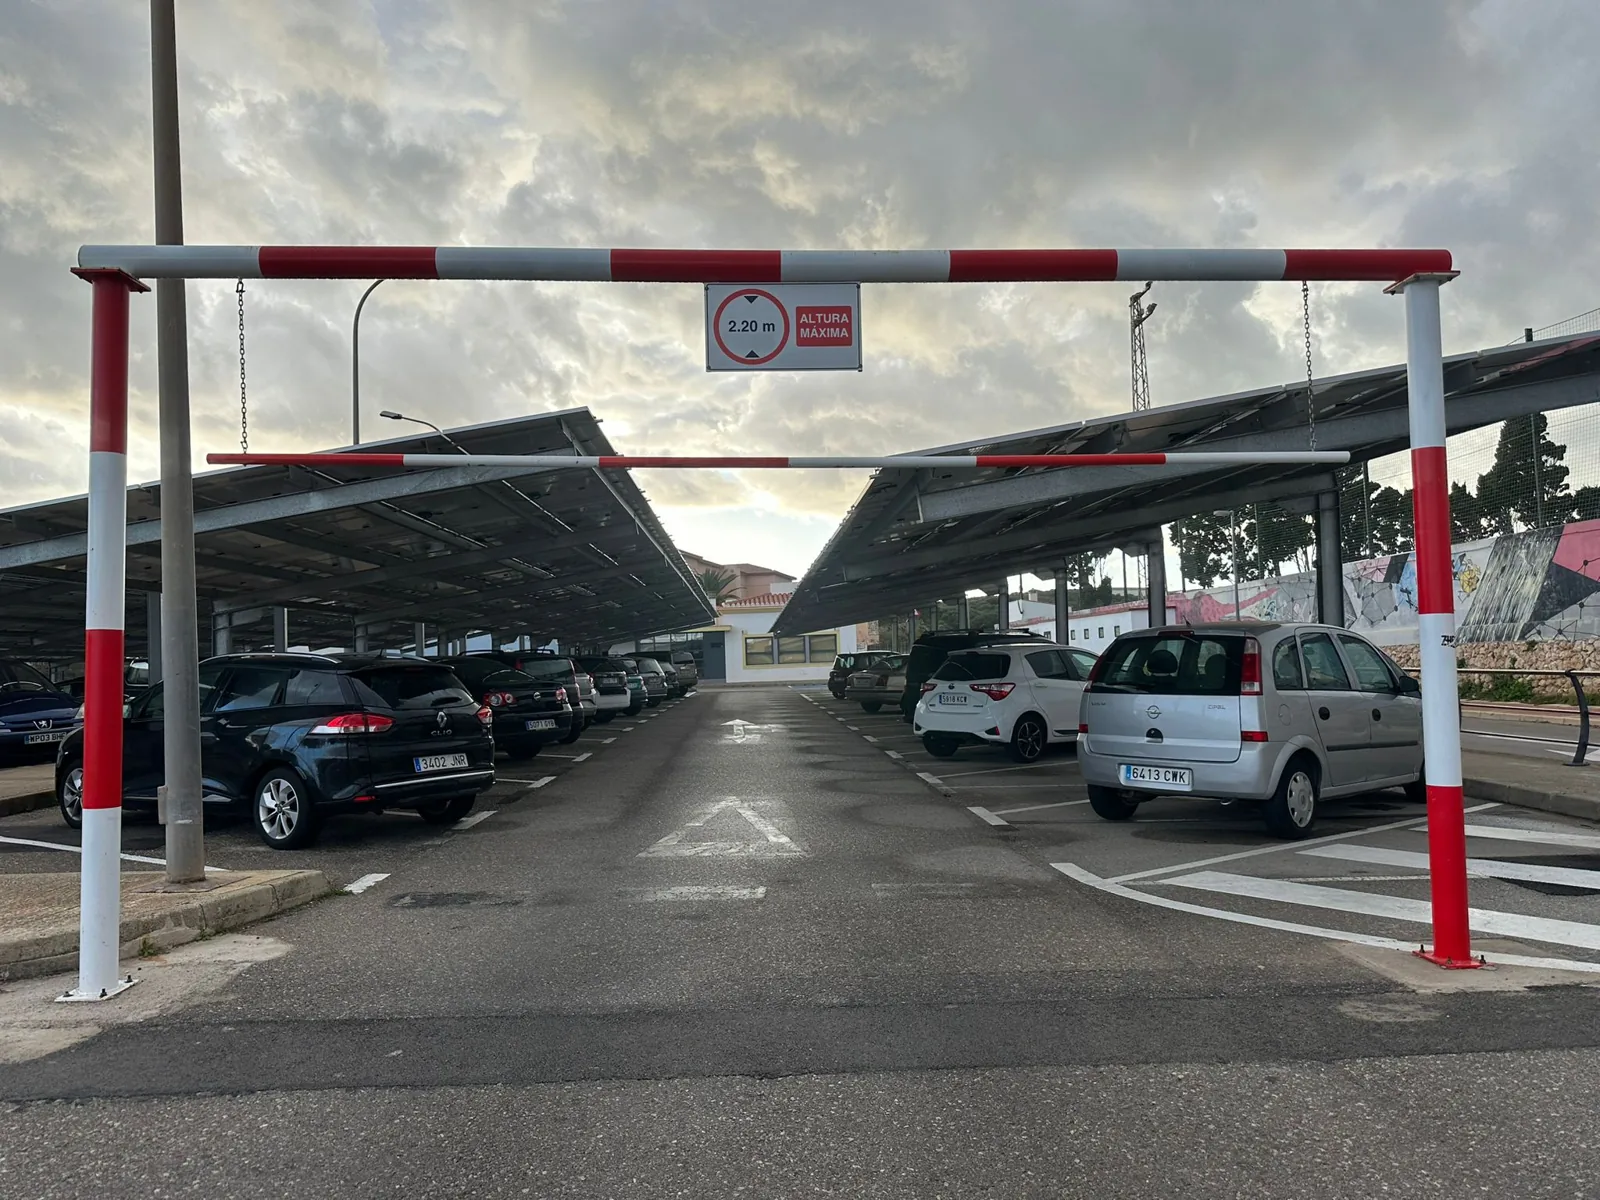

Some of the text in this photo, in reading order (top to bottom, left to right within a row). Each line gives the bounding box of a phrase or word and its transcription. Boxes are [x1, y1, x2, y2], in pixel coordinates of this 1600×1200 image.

[799, 313, 849, 323] ALTURA
[728, 320, 775, 332] 2.20 m
[800, 325, 849, 338] MÁXIMA
[942, 695, 956, 703] 5918
[30, 733, 50, 742] WP03
[421, 754, 467, 769] 3402 JNR
[1132, 767, 1186, 783] 6413 CWK
